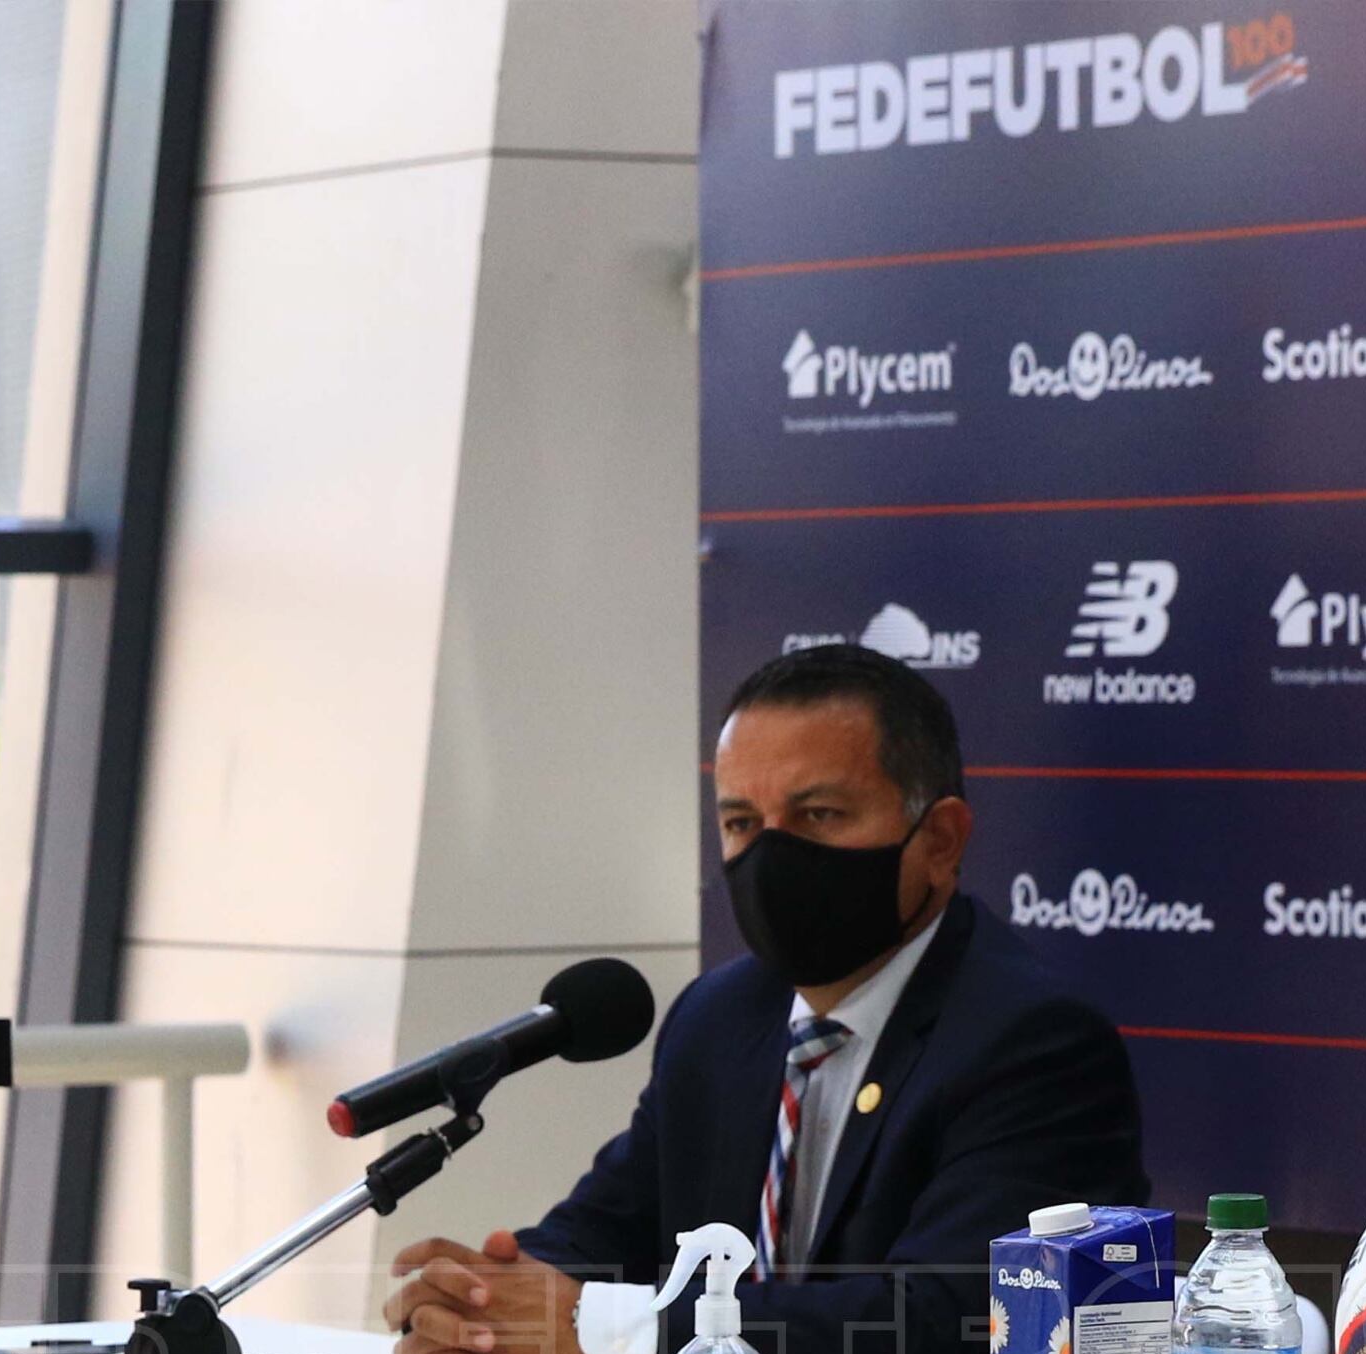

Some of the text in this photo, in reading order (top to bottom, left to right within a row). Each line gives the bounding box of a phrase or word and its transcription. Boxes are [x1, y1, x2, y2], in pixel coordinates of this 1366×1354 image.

[774, 23, 1249, 159] FEDEFUTBOL
[1226, 15, 1295, 67] 100
[824, 345, 953, 410] Plycem
[1009, 334, 1213, 397] Dos Pinos
[1043, 667, 1196, 704] new balance
[1011, 873, 1214, 933] Dos Pinos
[998, 1268, 1062, 1290] Dos Pinos
